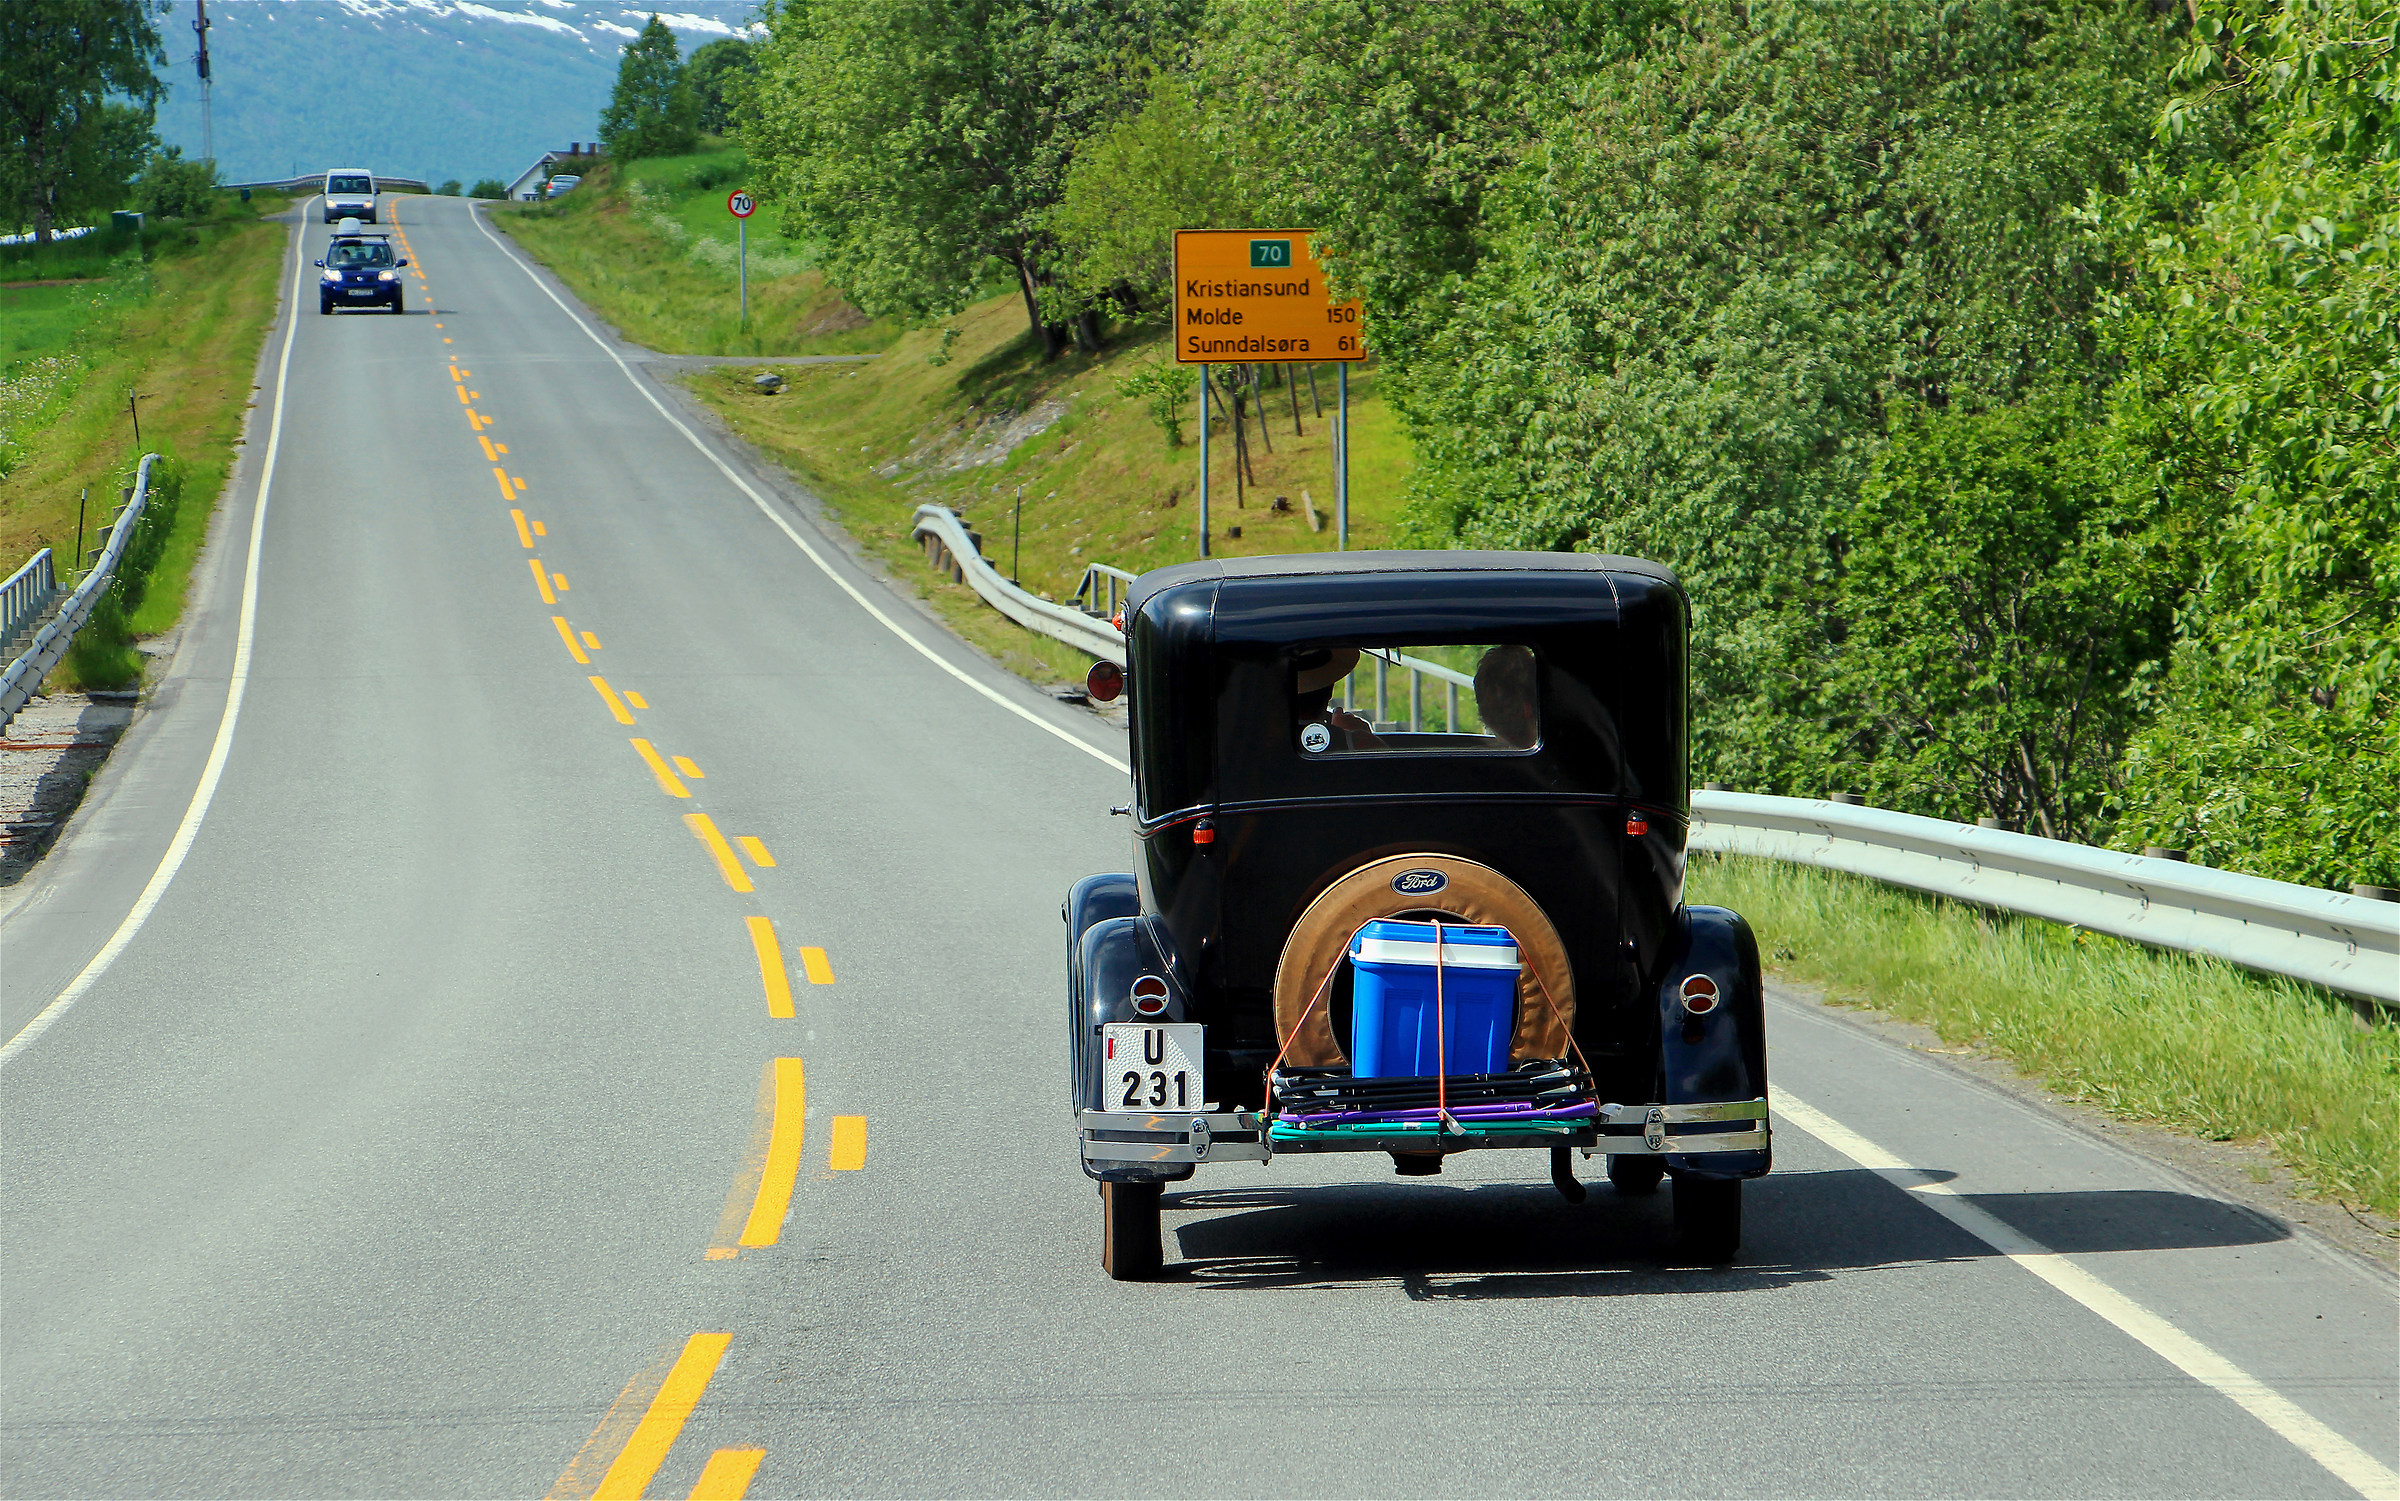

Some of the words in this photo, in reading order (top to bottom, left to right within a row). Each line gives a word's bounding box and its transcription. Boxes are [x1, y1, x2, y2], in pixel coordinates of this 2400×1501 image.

[733, 196, 751, 211] 70
[1259, 246, 1282, 261] 70
[1186, 279, 1310, 297] Kristiansund
[1186, 308, 1244, 325] Molde
[1326, 308, 1356, 323] 150
[1188, 335, 1310, 354] Sunndalsøra
[1337, 336, 1356, 351] 61
[1401, 873, 1438, 890] Ford
[1144, 1029, 1164, 1066] U
[1122, 1070, 1186, 1107] 231
